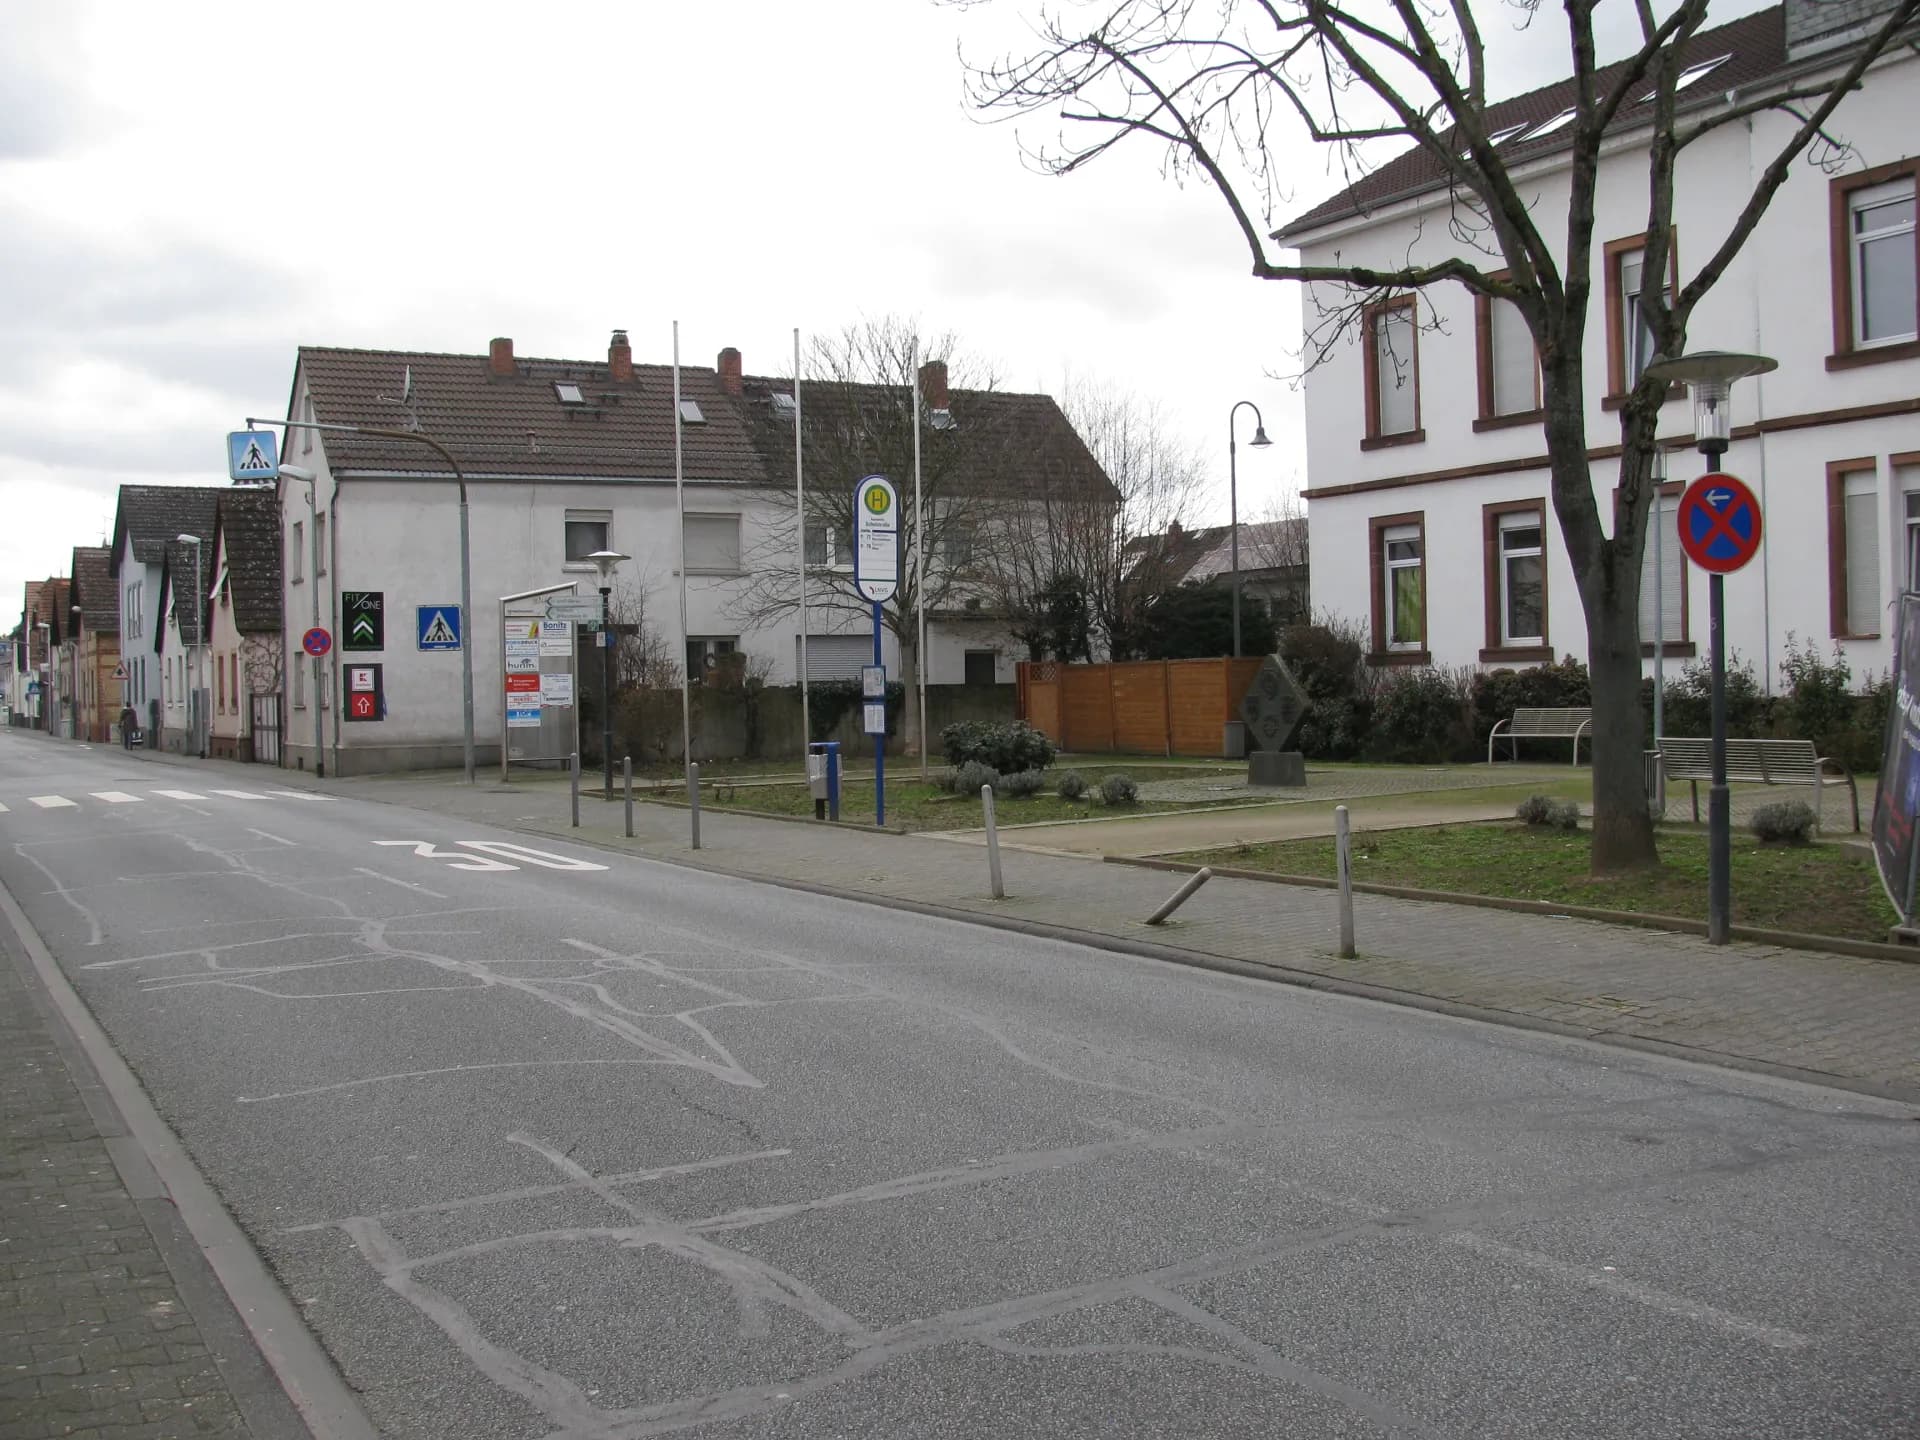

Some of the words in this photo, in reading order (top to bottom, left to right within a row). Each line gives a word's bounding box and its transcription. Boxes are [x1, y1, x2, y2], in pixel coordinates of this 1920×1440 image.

[872, 491, 883, 509] H
[345, 593, 360, 601] FIT
[361, 600, 381, 610] ONE
